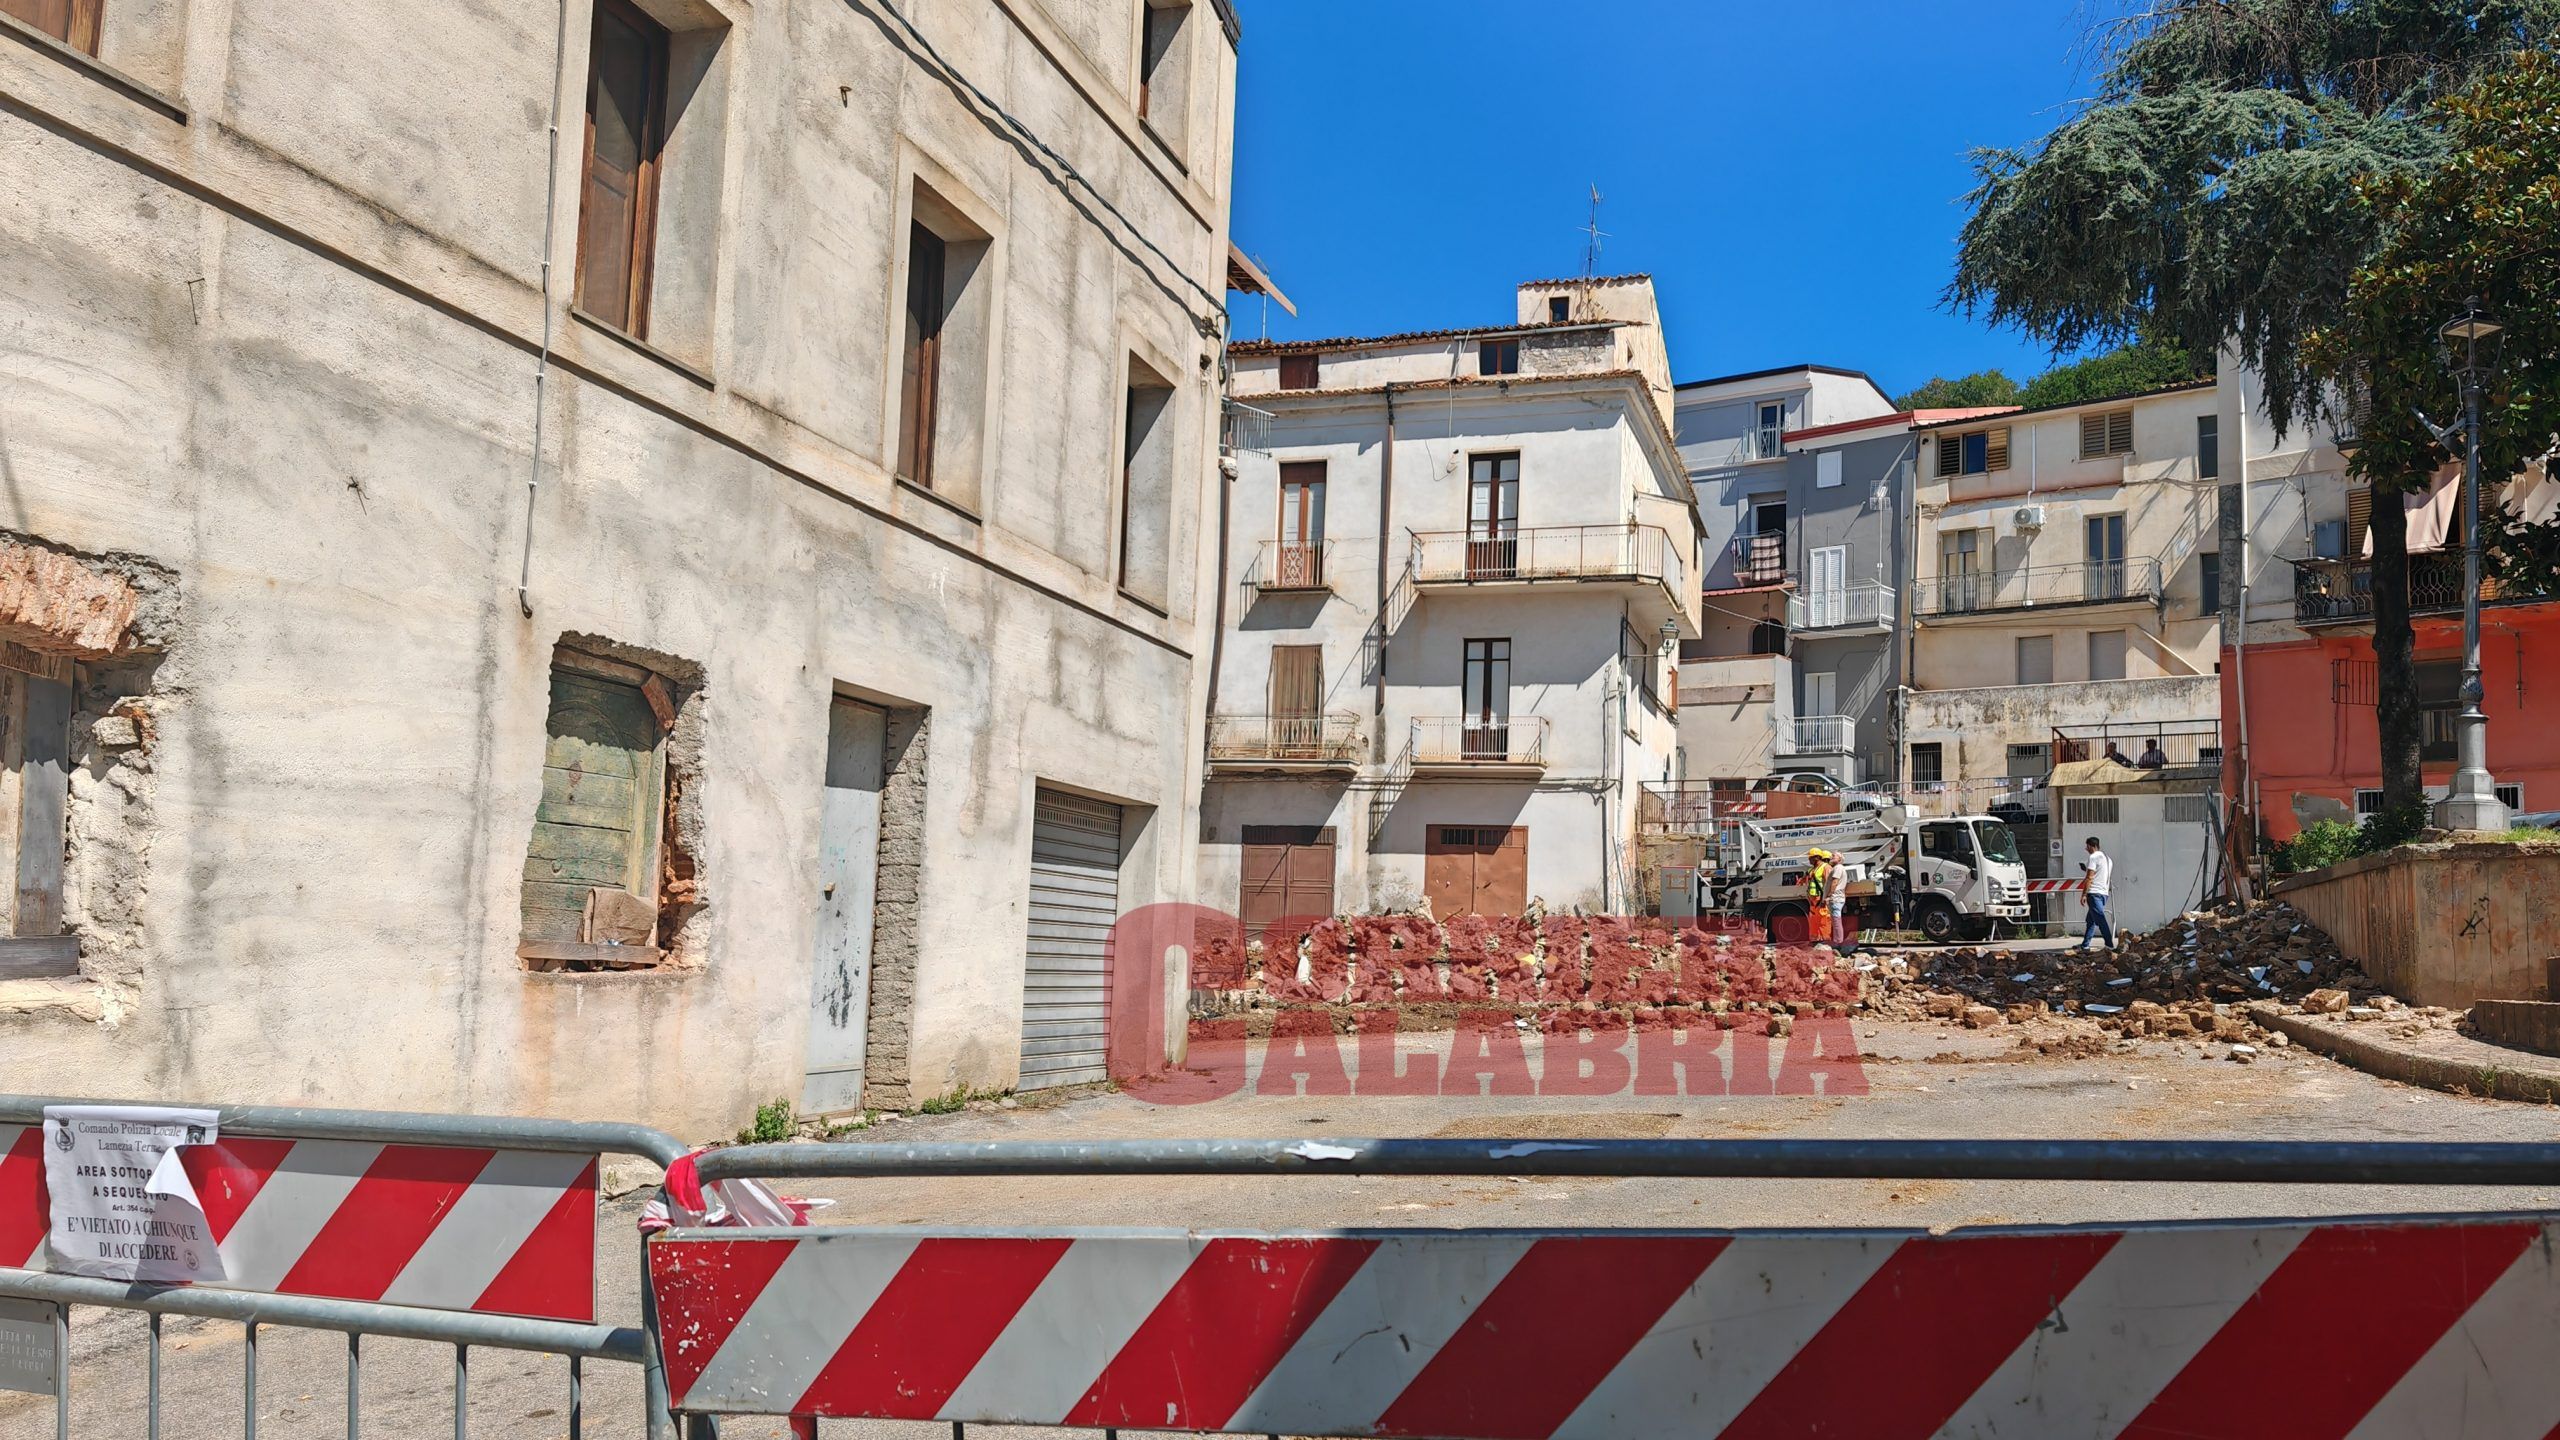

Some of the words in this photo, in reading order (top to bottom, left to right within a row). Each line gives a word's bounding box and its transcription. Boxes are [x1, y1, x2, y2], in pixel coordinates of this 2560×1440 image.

[1775, 829, 1814, 839] snake
[78, 1121, 119, 1134] Comando
[121, 1121, 151, 1135] Polizia
[153, 1123, 182, 1137] Locale
[98, 1139, 133, 1152] Lamezia
[76, 1165, 107, 1177] AREA
[111, 1166, 153, 1179] SOTTOP
[93, 1185, 99, 1197] A
[127, 1204, 139, 1212] 354
[81, 1217, 131, 1235] VIETATO
[133, 1220, 141, 1235] A
[143, 1220, 199, 1242] CHIUNQUE
[99, 1241, 111, 1257] DI
[114, 1243, 179, 1261] ACCEDERE
